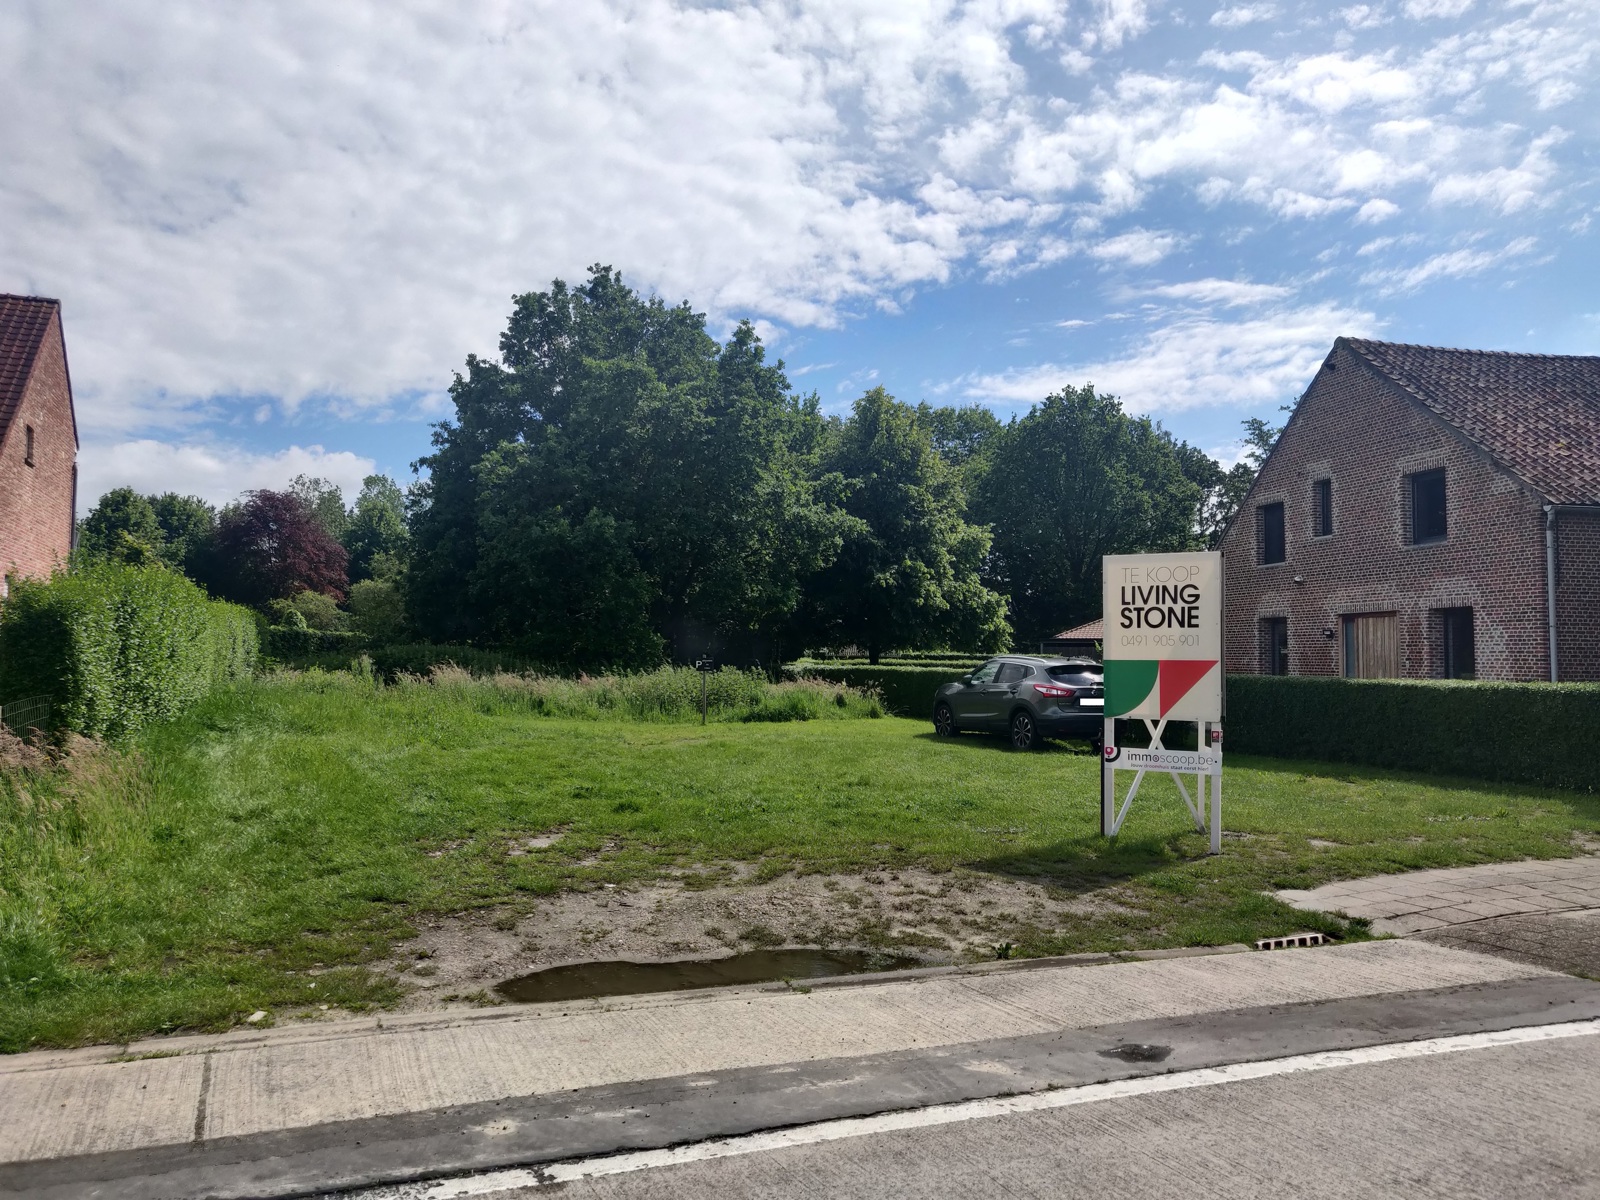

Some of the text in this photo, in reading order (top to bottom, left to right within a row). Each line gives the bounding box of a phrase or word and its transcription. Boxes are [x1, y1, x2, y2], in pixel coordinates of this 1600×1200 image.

[1121, 566, 1200, 584] TE KOOP
[1121, 584, 1201, 606] LIVING
[1120, 606, 1200, 629] STONE
[1121, 634, 1200, 647] 0491 905 901
[695, 660, 702, 669] P
[1127, 750, 1213, 766] immoscoop.be
